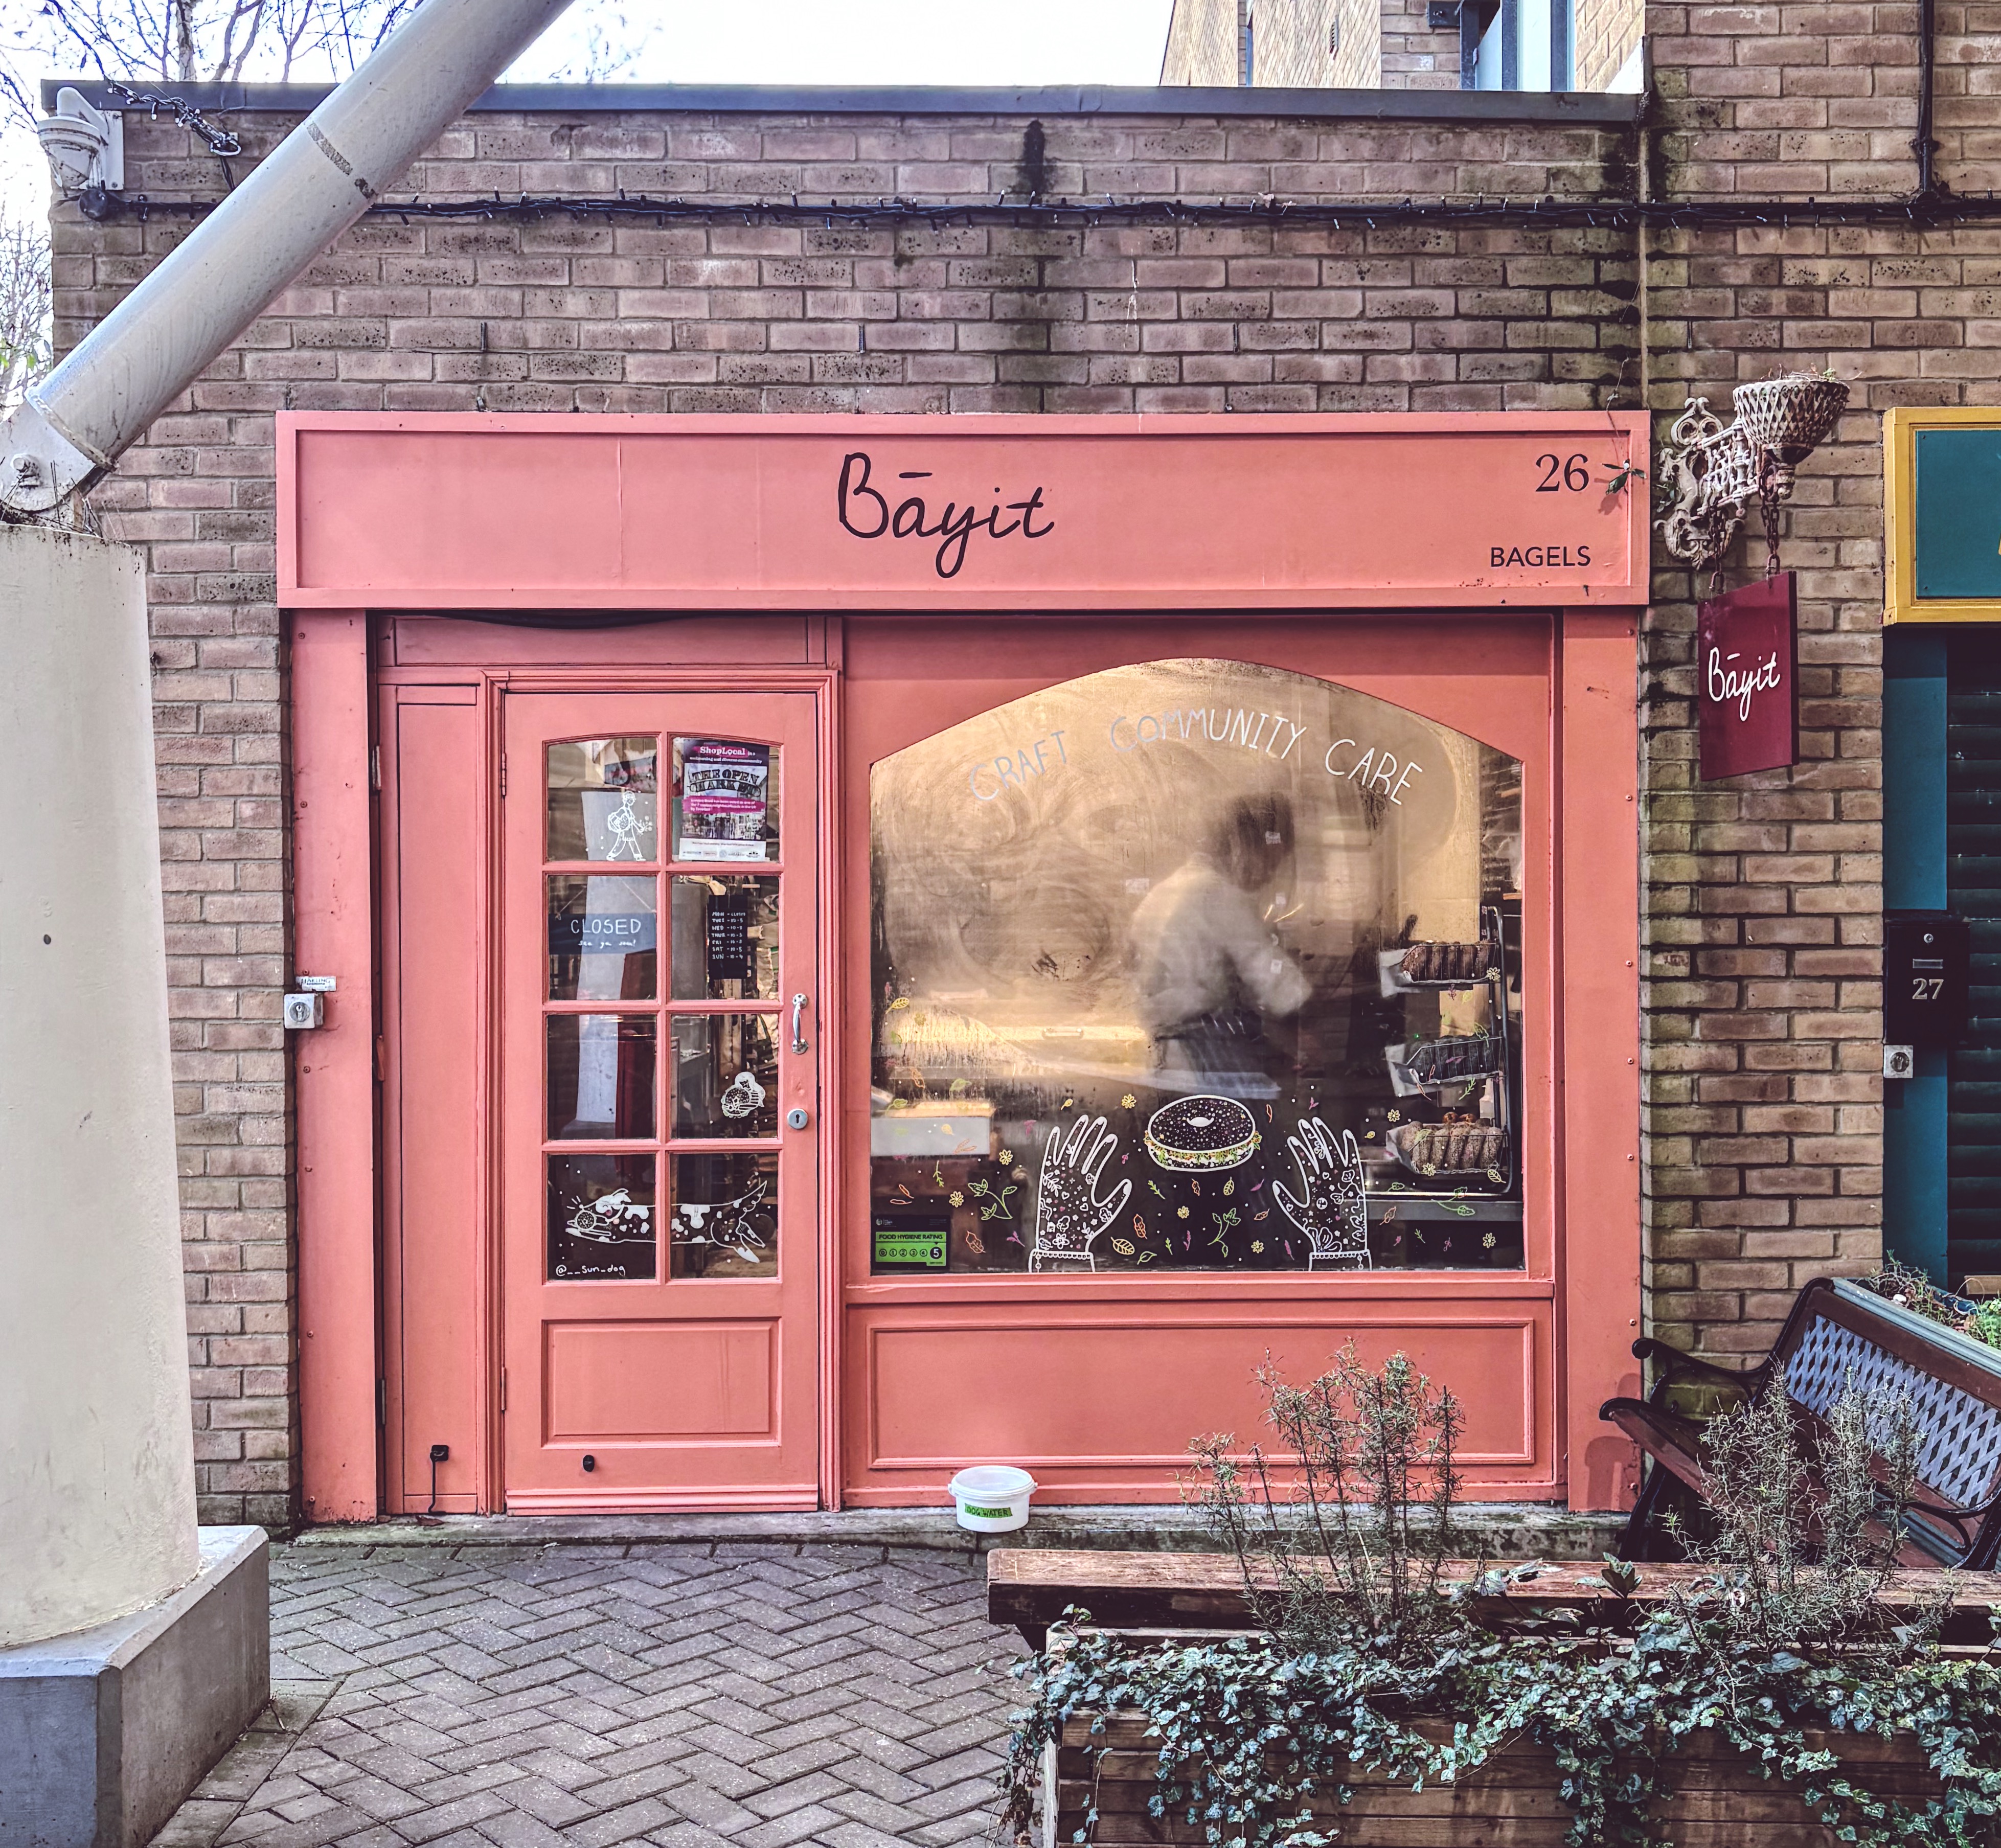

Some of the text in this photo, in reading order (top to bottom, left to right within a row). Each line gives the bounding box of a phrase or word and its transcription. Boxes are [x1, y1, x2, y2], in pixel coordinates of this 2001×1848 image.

[1535, 453, 1589, 492] 26
[838, 452, 1054, 578] Bāyit
[1491, 545, 1590, 567] BAGELS
[1709, 647, 1780, 721] Bāyit
[700, 746, 745, 756] ShopLocal
[970, 708, 1422, 805] CRAFT COMMUNITY CARE
[692, 769, 760, 786] THE OPEN
[571, 919, 641, 934] CLOSED
[1912, 978, 1944, 999] 27
[934, 1248, 939, 1258] 5
[966, 1507, 1009, 1518] DOG WATER
